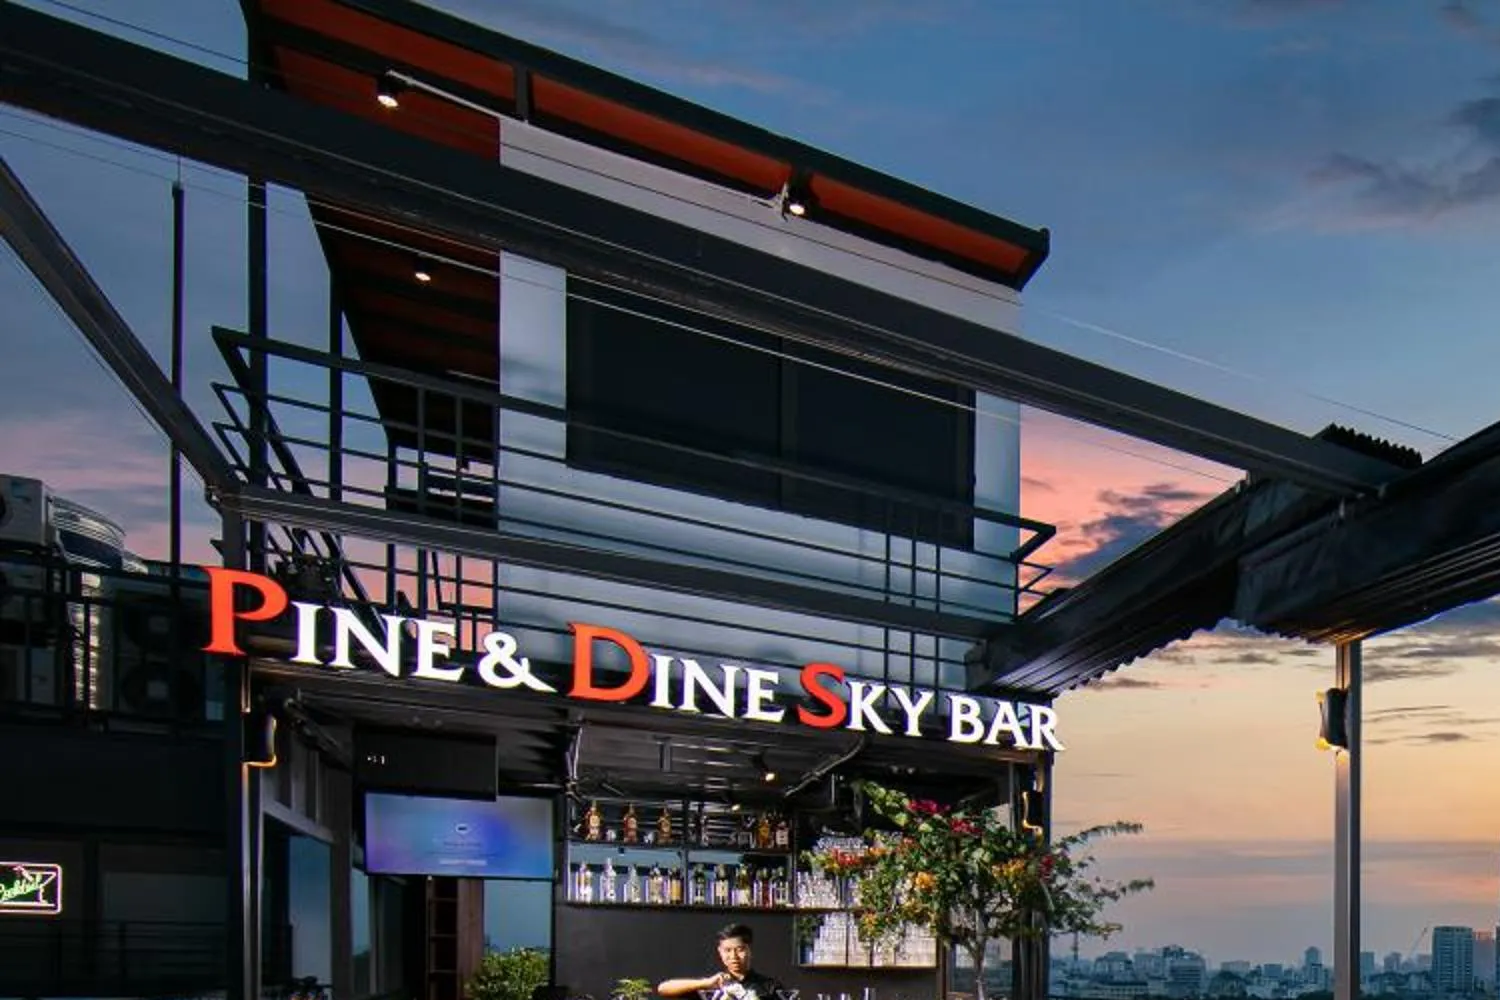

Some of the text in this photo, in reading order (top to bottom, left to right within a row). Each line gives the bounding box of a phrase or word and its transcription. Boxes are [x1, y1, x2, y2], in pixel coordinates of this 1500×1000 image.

[203, 566, 1066, 751] PINE & DINE SKY BAR
